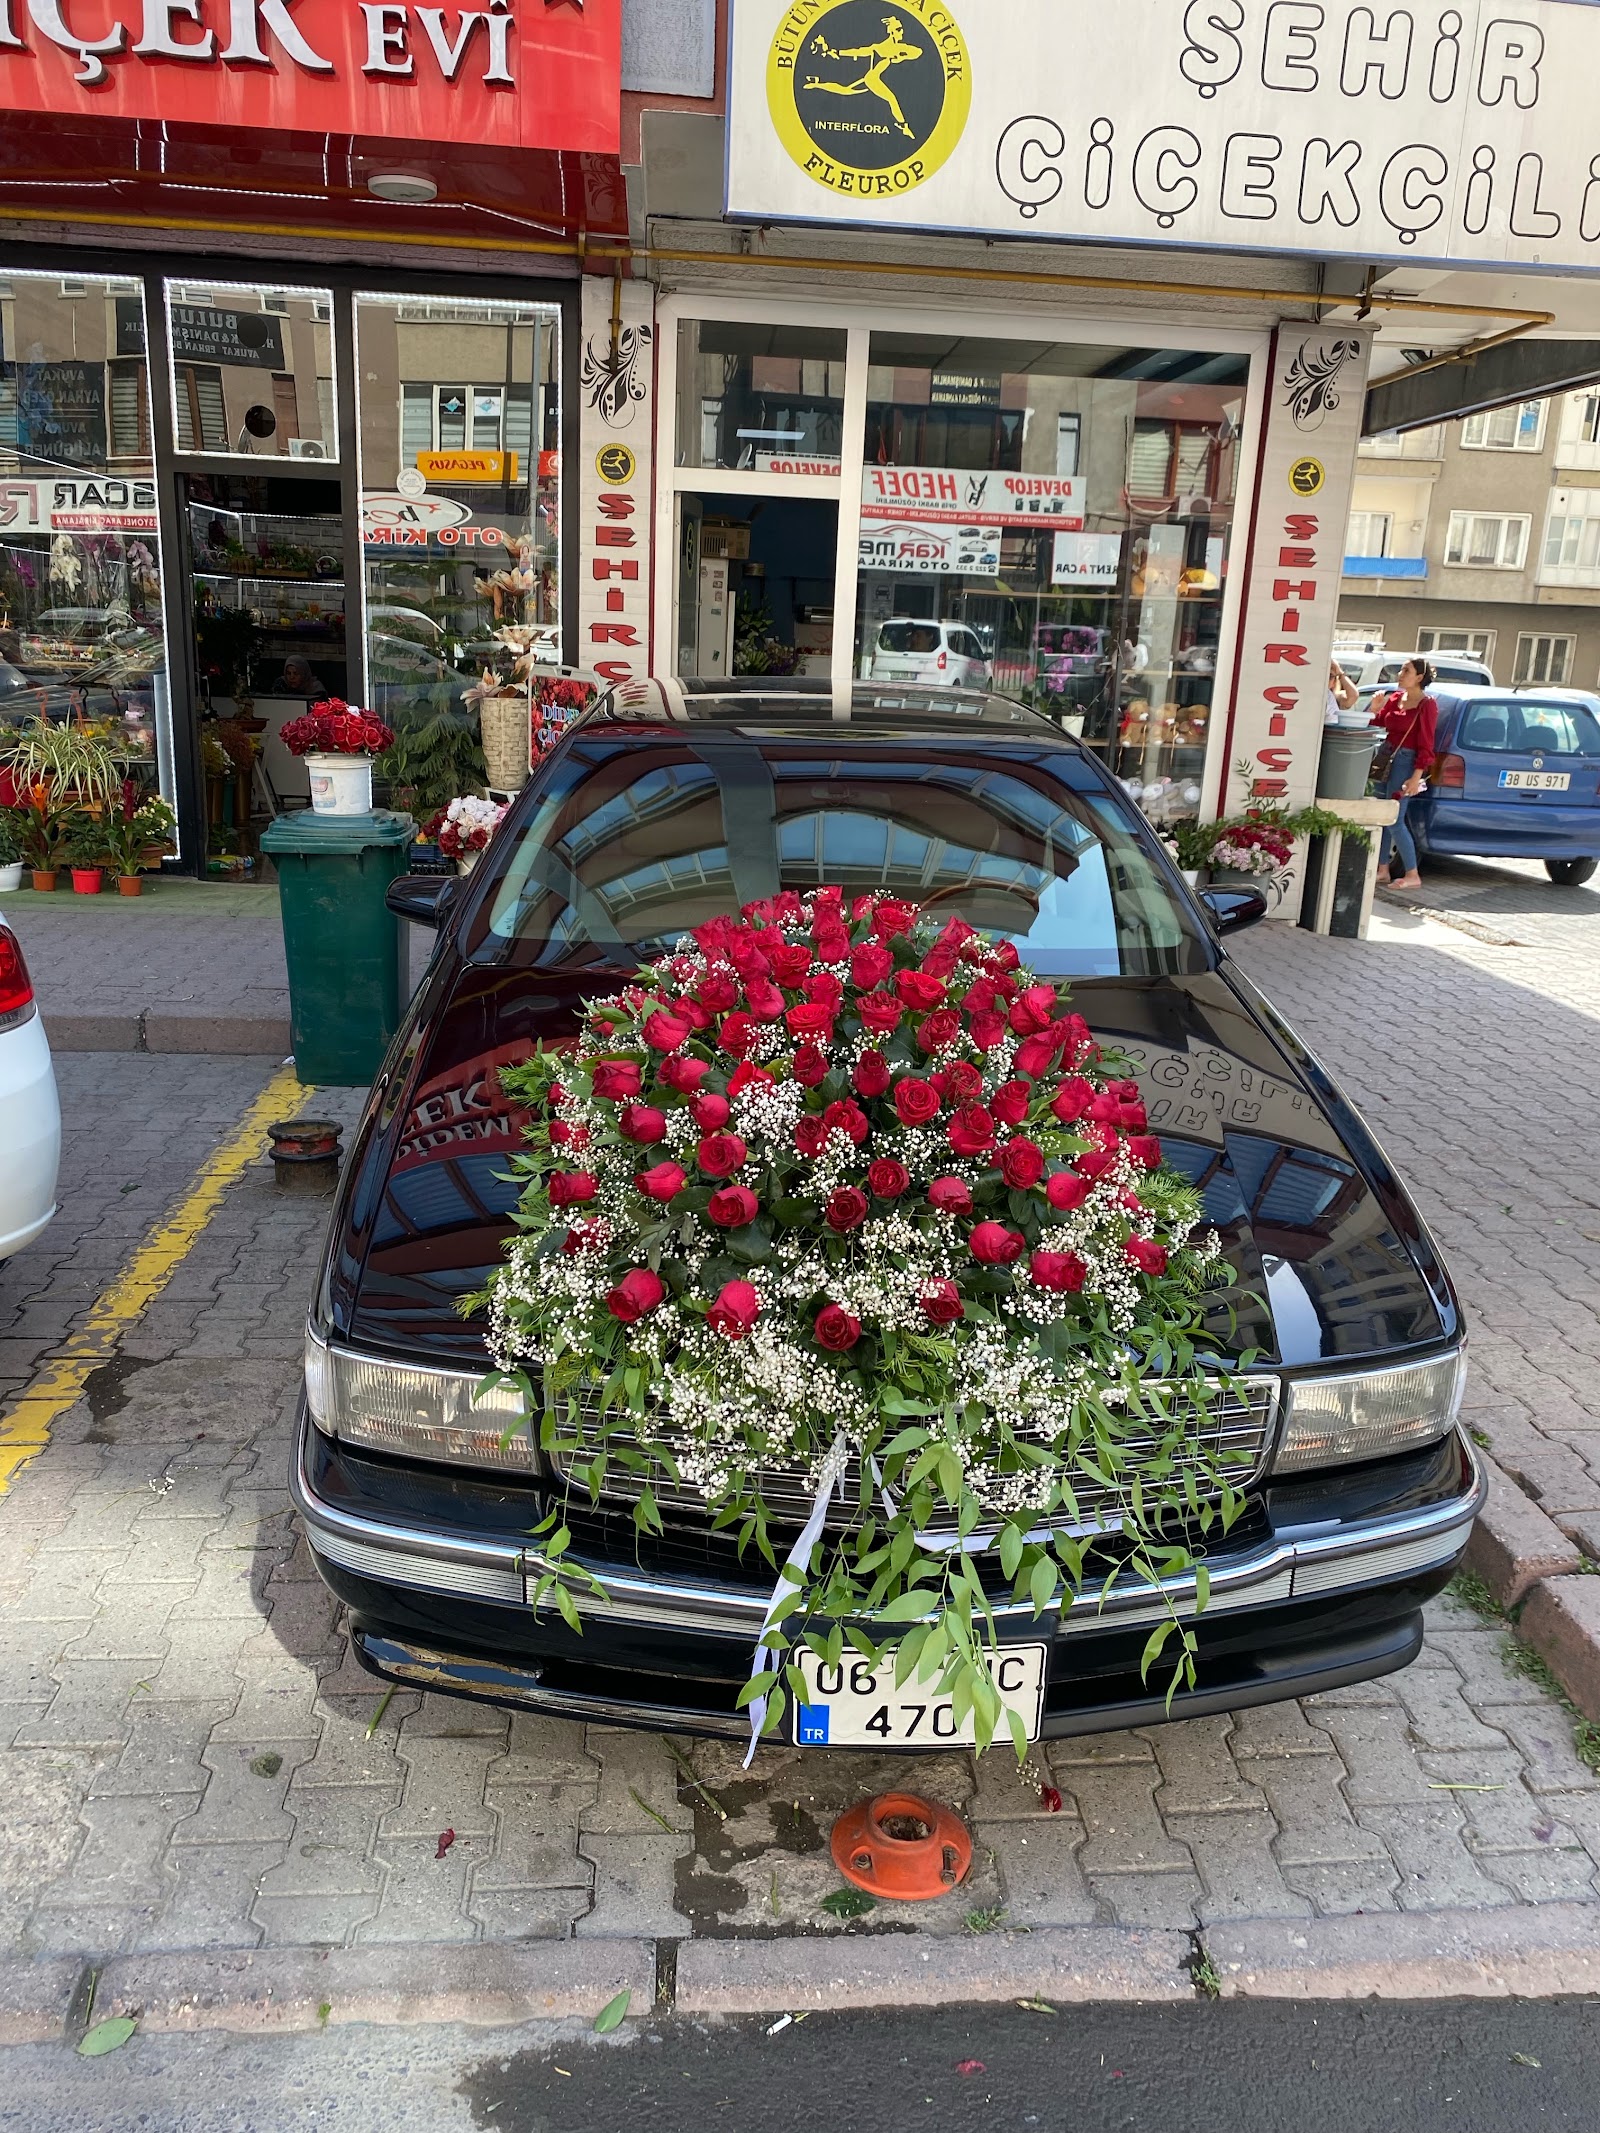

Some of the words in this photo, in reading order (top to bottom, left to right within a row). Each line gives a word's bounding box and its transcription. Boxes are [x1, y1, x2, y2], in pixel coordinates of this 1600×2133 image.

[358, 0, 515, 82] EVİ
[775, 0, 821, 69] BÜTÜN
[927, 11, 964, 82] ÇİÇEK
[1180, 0, 1545, 109] ŞEHİR
[815, 120, 890, 135] INTERFLORA
[803, 152, 925, 194] FLEUROP
[1506, 773, 1520, 786] 38
[1526, 774, 1540, 787] US
[1545, 775, 1565, 788] 971
[815, 1660, 878, 1696] 06
[804, 1728, 824, 1740] TR
